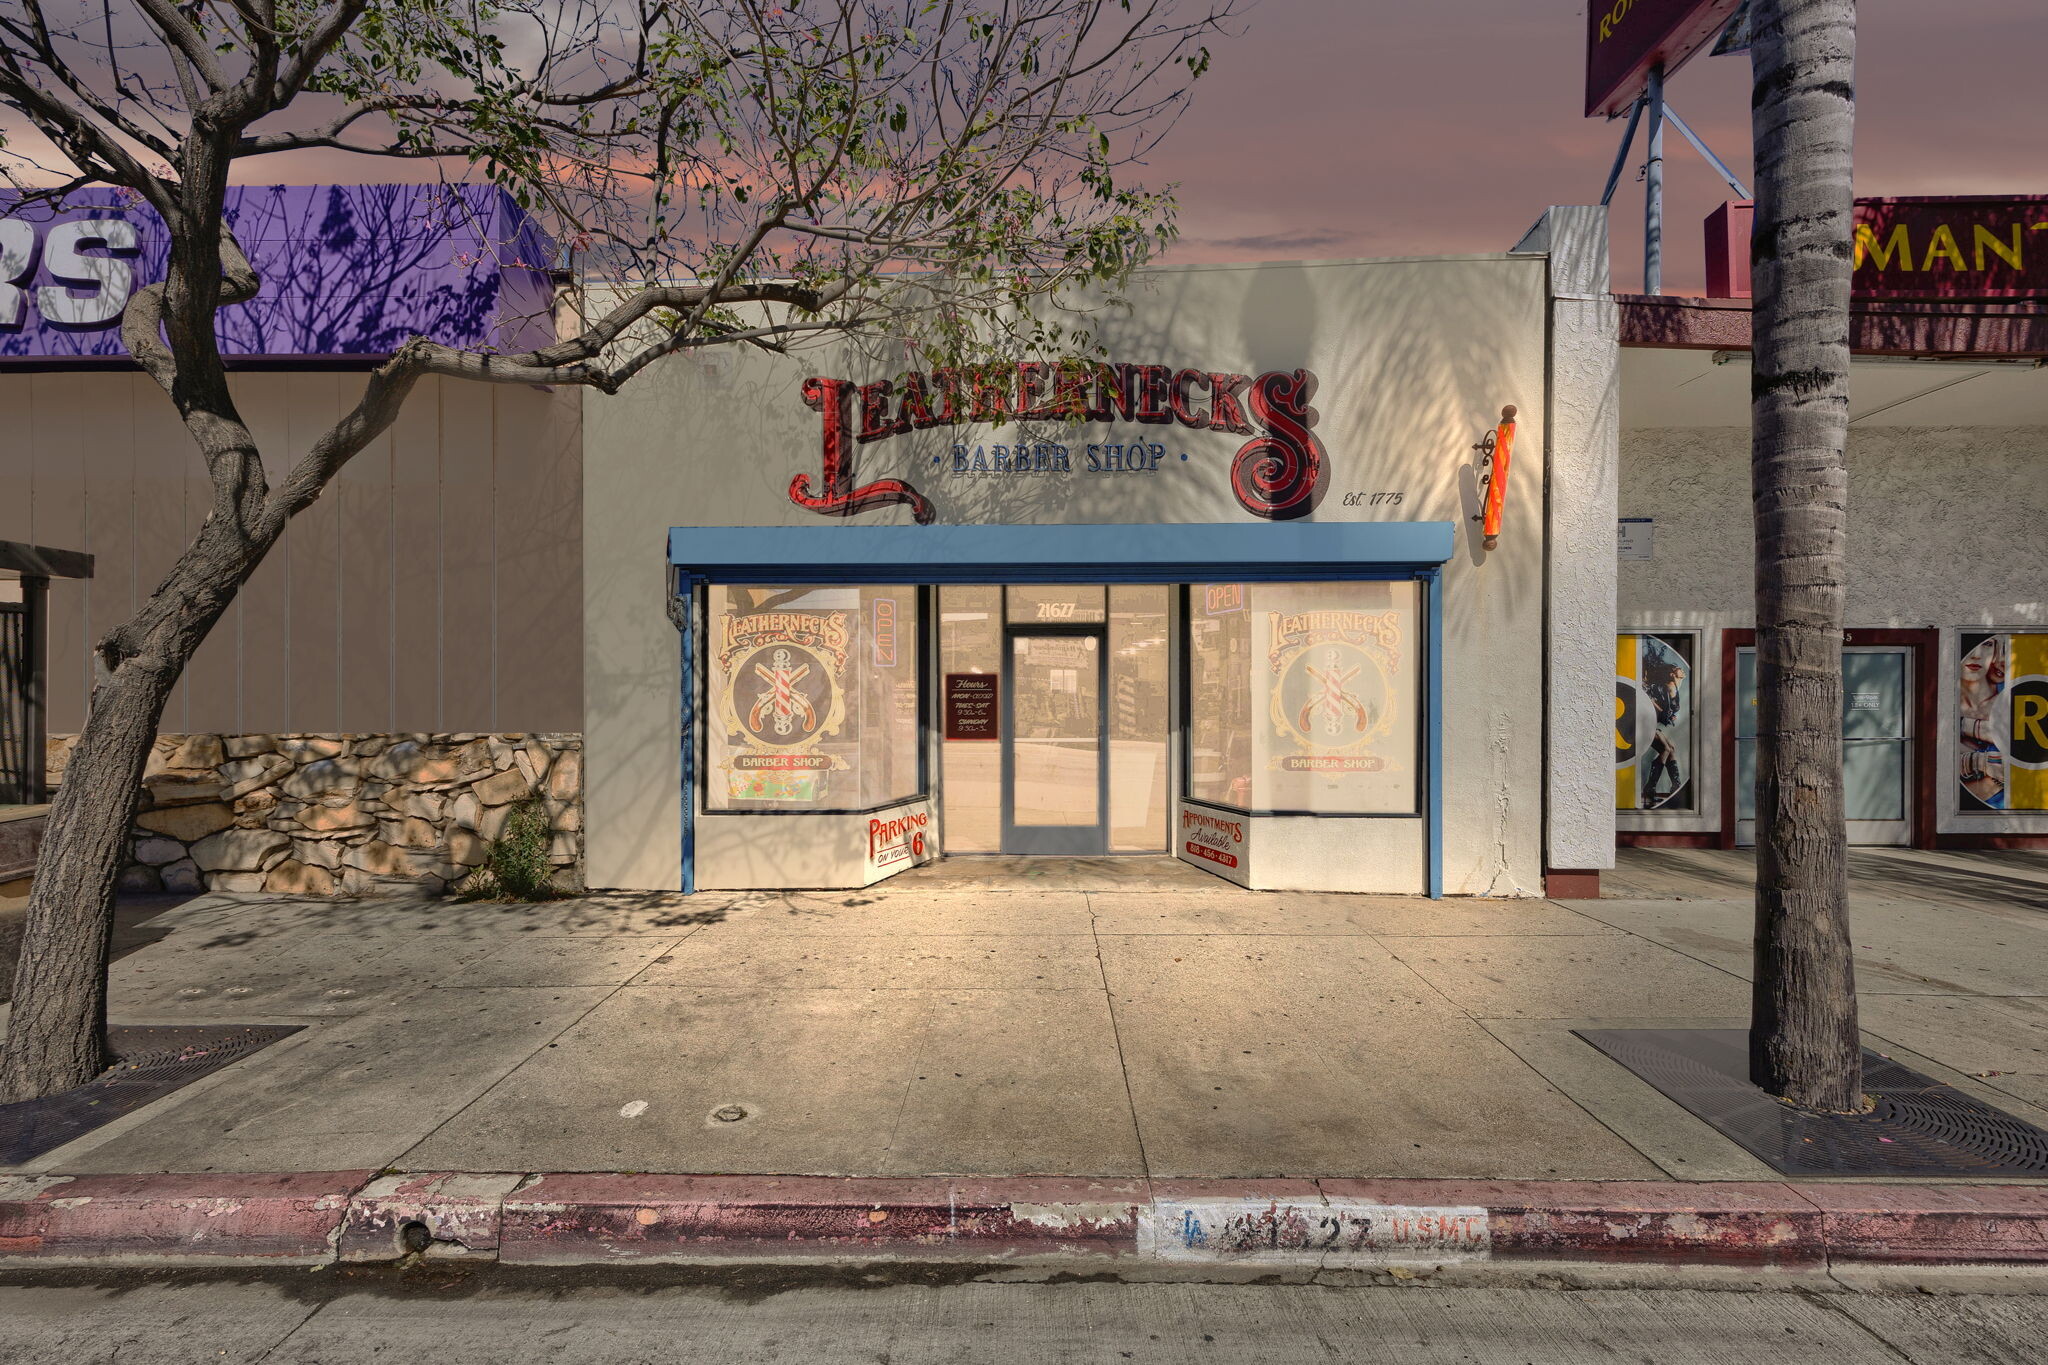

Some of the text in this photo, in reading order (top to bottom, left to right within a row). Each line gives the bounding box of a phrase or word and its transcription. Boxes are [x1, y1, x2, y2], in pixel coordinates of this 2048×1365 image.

[1599, 0, 1633, 43] RO
[1853, 221, 2048, 272] MAN
[788, 362, 1331, 525] LEATHERNECKS
[952, 443, 1166, 472] BARBER SHOP
[1370, 492, 1404, 506] 1775
[1037, 602, 1076, 618] 21627
[1208, 584, 1241, 609] OPEN
[719, 611, 849, 656] LEATHERNECKS
[877, 602, 893, 661] OPEN
[1268, 610, 1402, 654] LEATHERNECKS
[955, 679, 989, 689] Hours
[743, 757, 824, 767] BARBER SHOP
[1291, 759, 1376, 769] BARBER SHOP
[869, 813, 927, 858] PARKING
[1183, 810, 1243, 843] APPOINTMENTS
[1191, 828, 1231, 850] Available
[878, 853, 889, 863] ON
